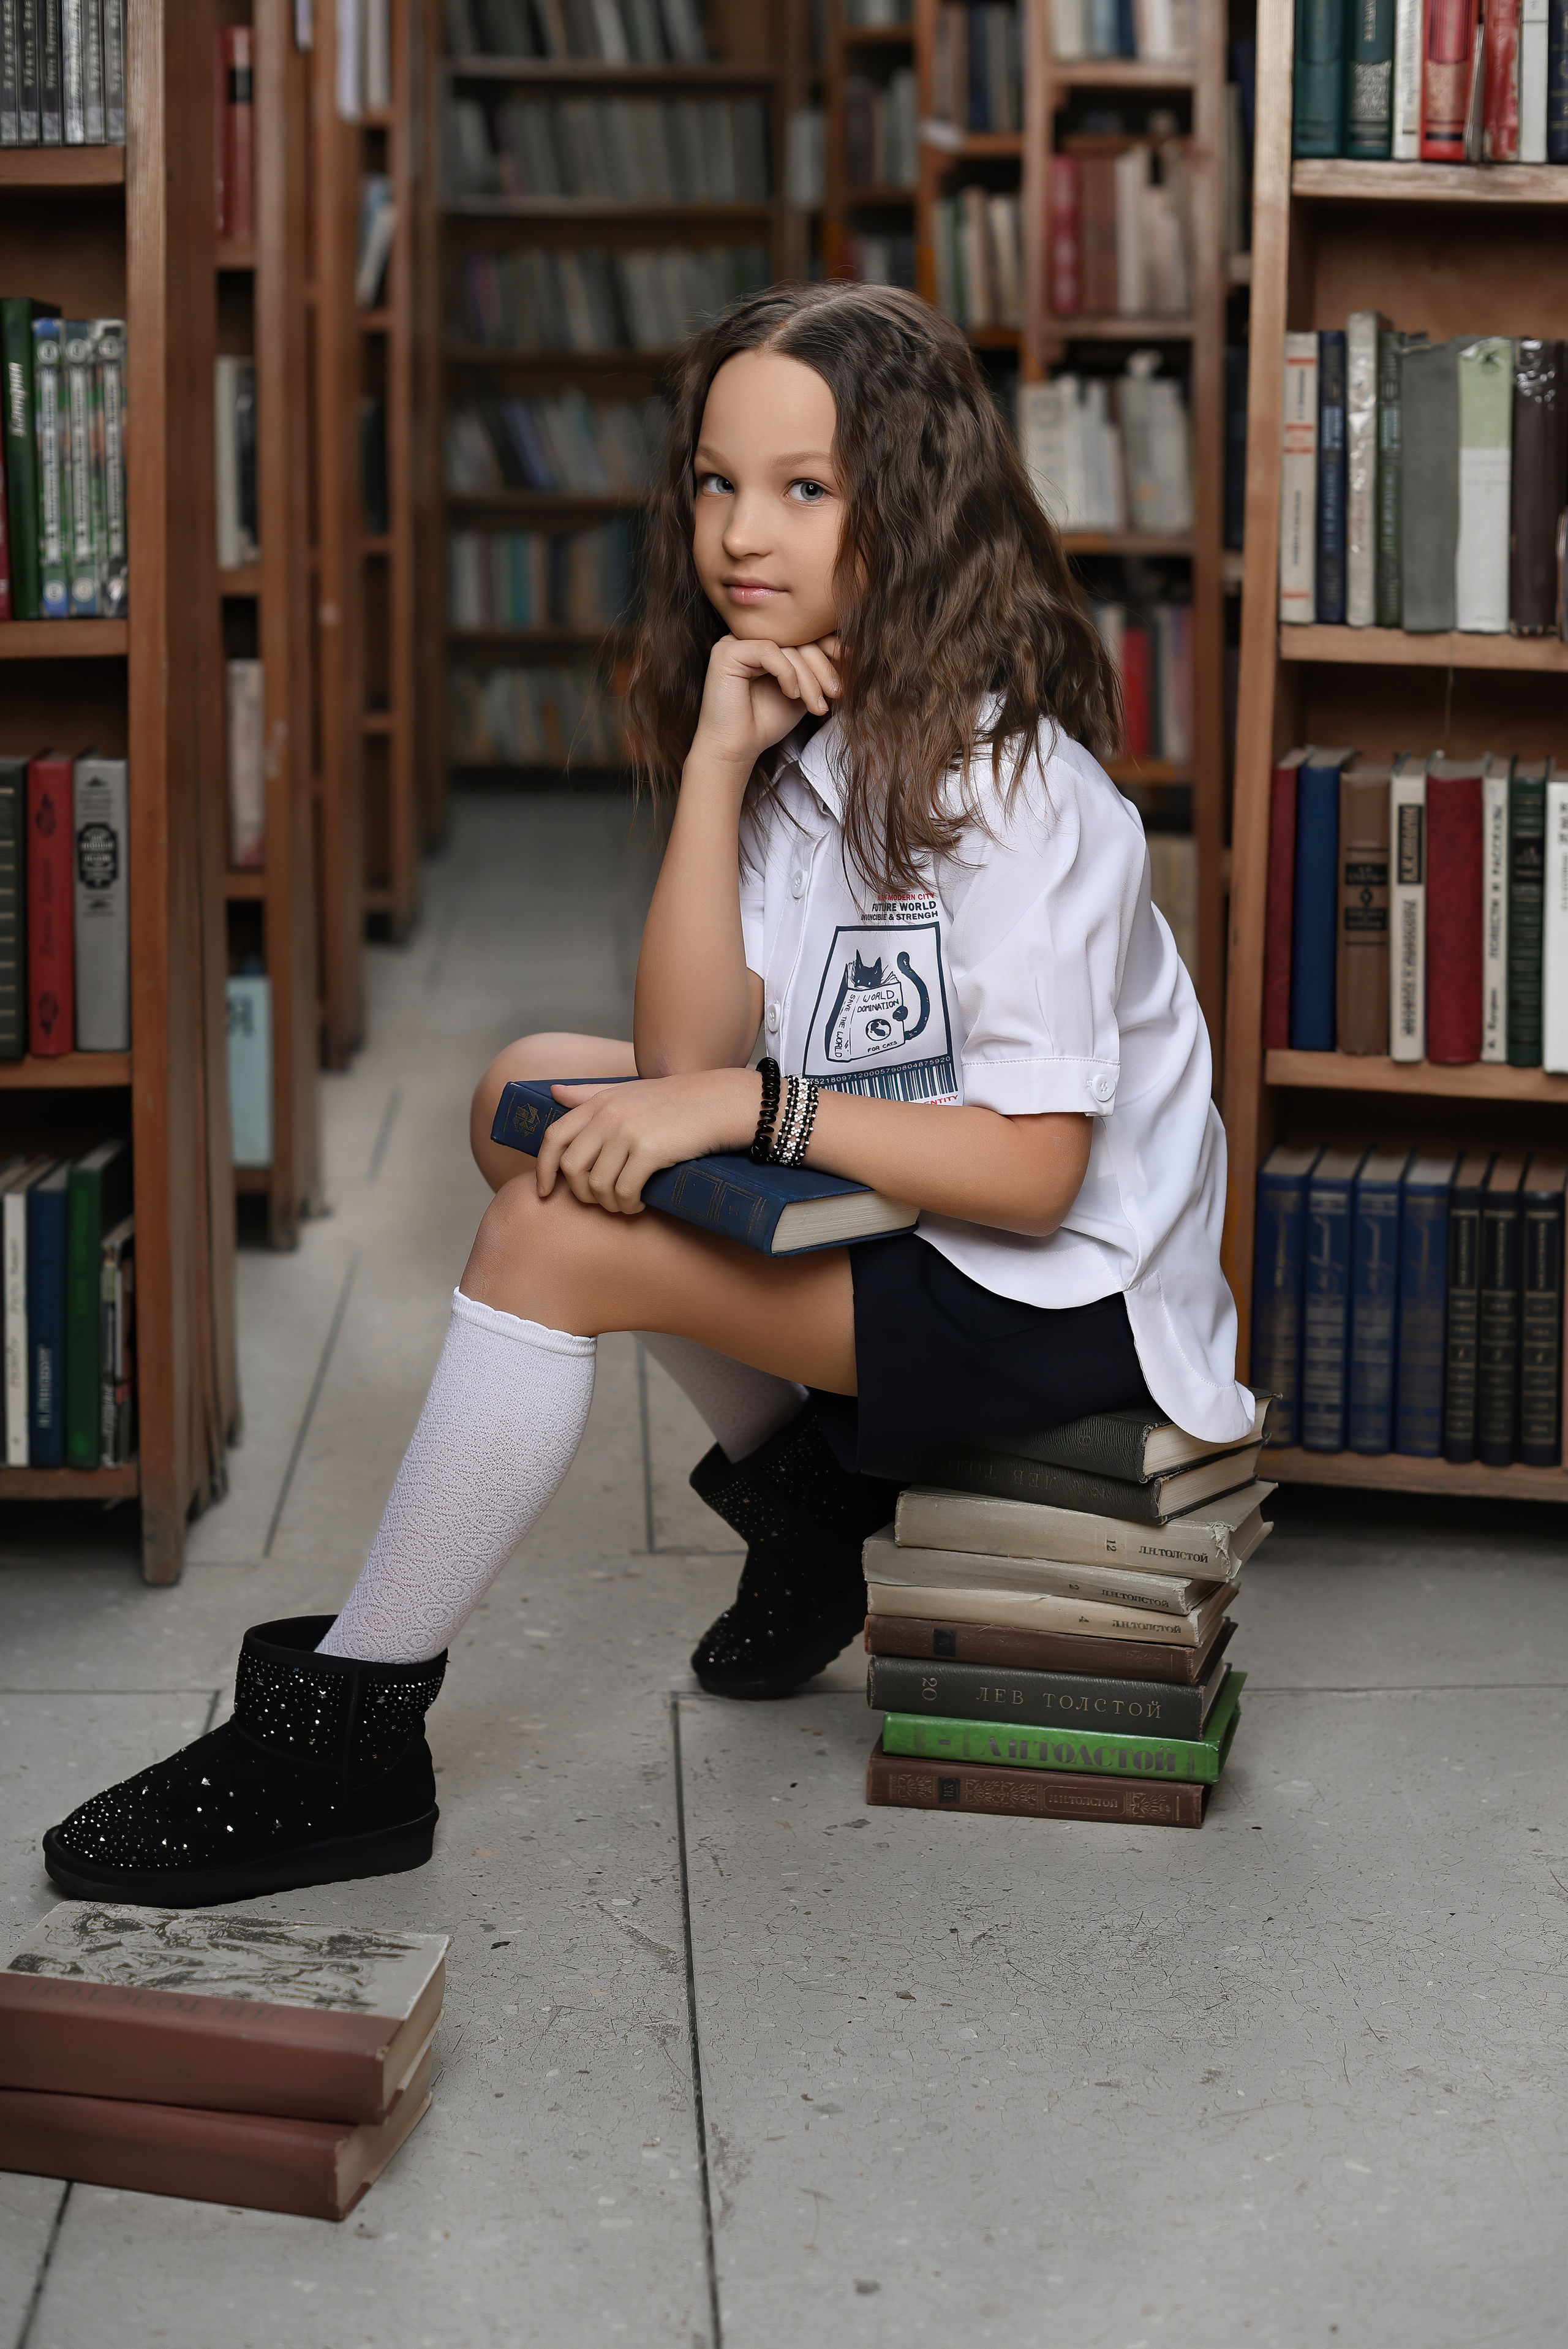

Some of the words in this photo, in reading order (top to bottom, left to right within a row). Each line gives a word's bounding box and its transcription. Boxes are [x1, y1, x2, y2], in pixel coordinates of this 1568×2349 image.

[872, 902, 897, 912] FUTURE
[899, 901, 937, 911] WORLD
[896, 910, 938, 920] STRENGH
[845, 994, 856, 1012] SAVE
[863, 990, 894, 1002] WORLD
[858, 999, 899, 1013] DOMINATION
[839, 1016, 847, 1029] THE
[835, 1031, 843, 1057] WORLD
[807, 1056, 951, 1084] 75218097120005790804875920
[1106, 1538, 1117, 1552] 12
[922, 1678, 937, 1701] 20
[976, 1687, 1024, 1704] ЛЕВ
[1042, 1693, 1162, 1719] ТОЛСТОЙ
